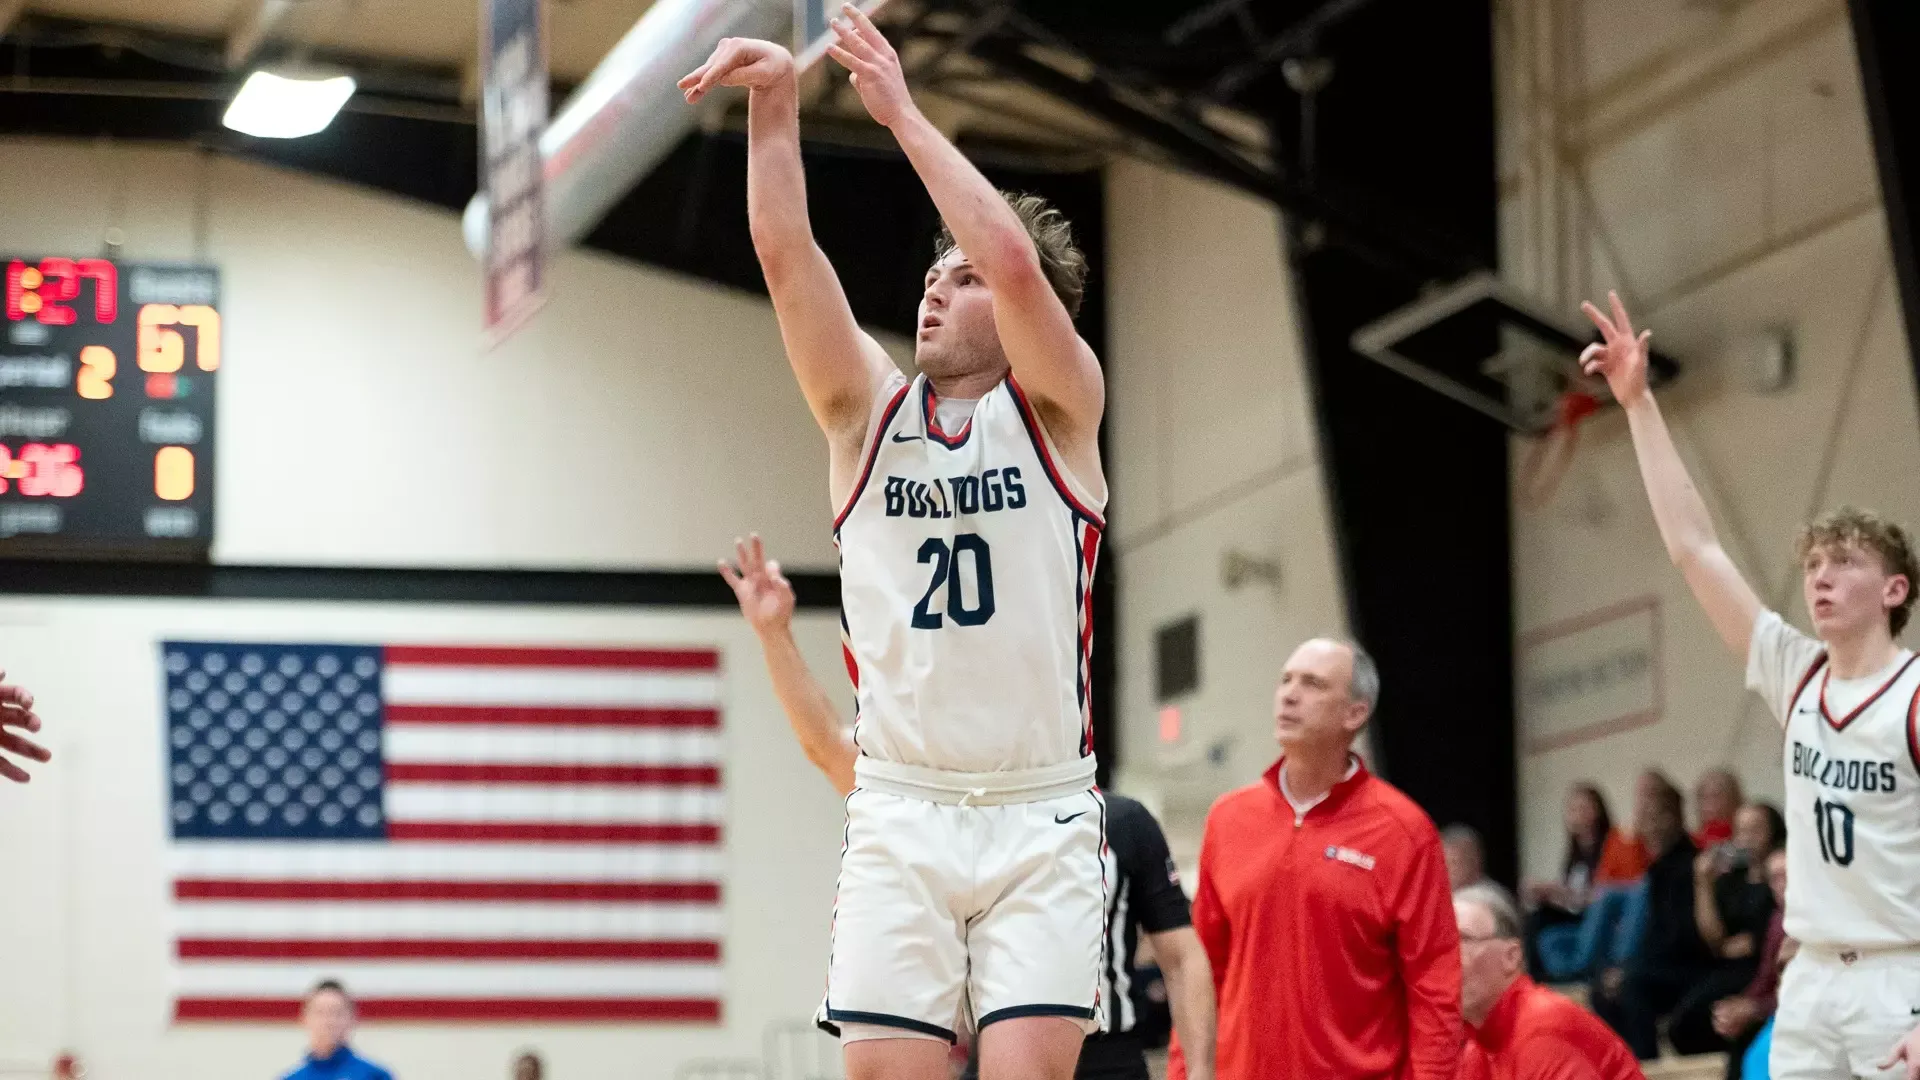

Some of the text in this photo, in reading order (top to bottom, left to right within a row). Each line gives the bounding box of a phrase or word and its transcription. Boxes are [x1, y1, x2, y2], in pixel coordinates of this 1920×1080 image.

[76, 345, 118, 400] 2
[136, 303, 221, 373] 67
[911, 533, 996, 630] 20
[1793, 741, 1897, 793] BULLDOGS
[1814, 797, 1855, 868] 10
